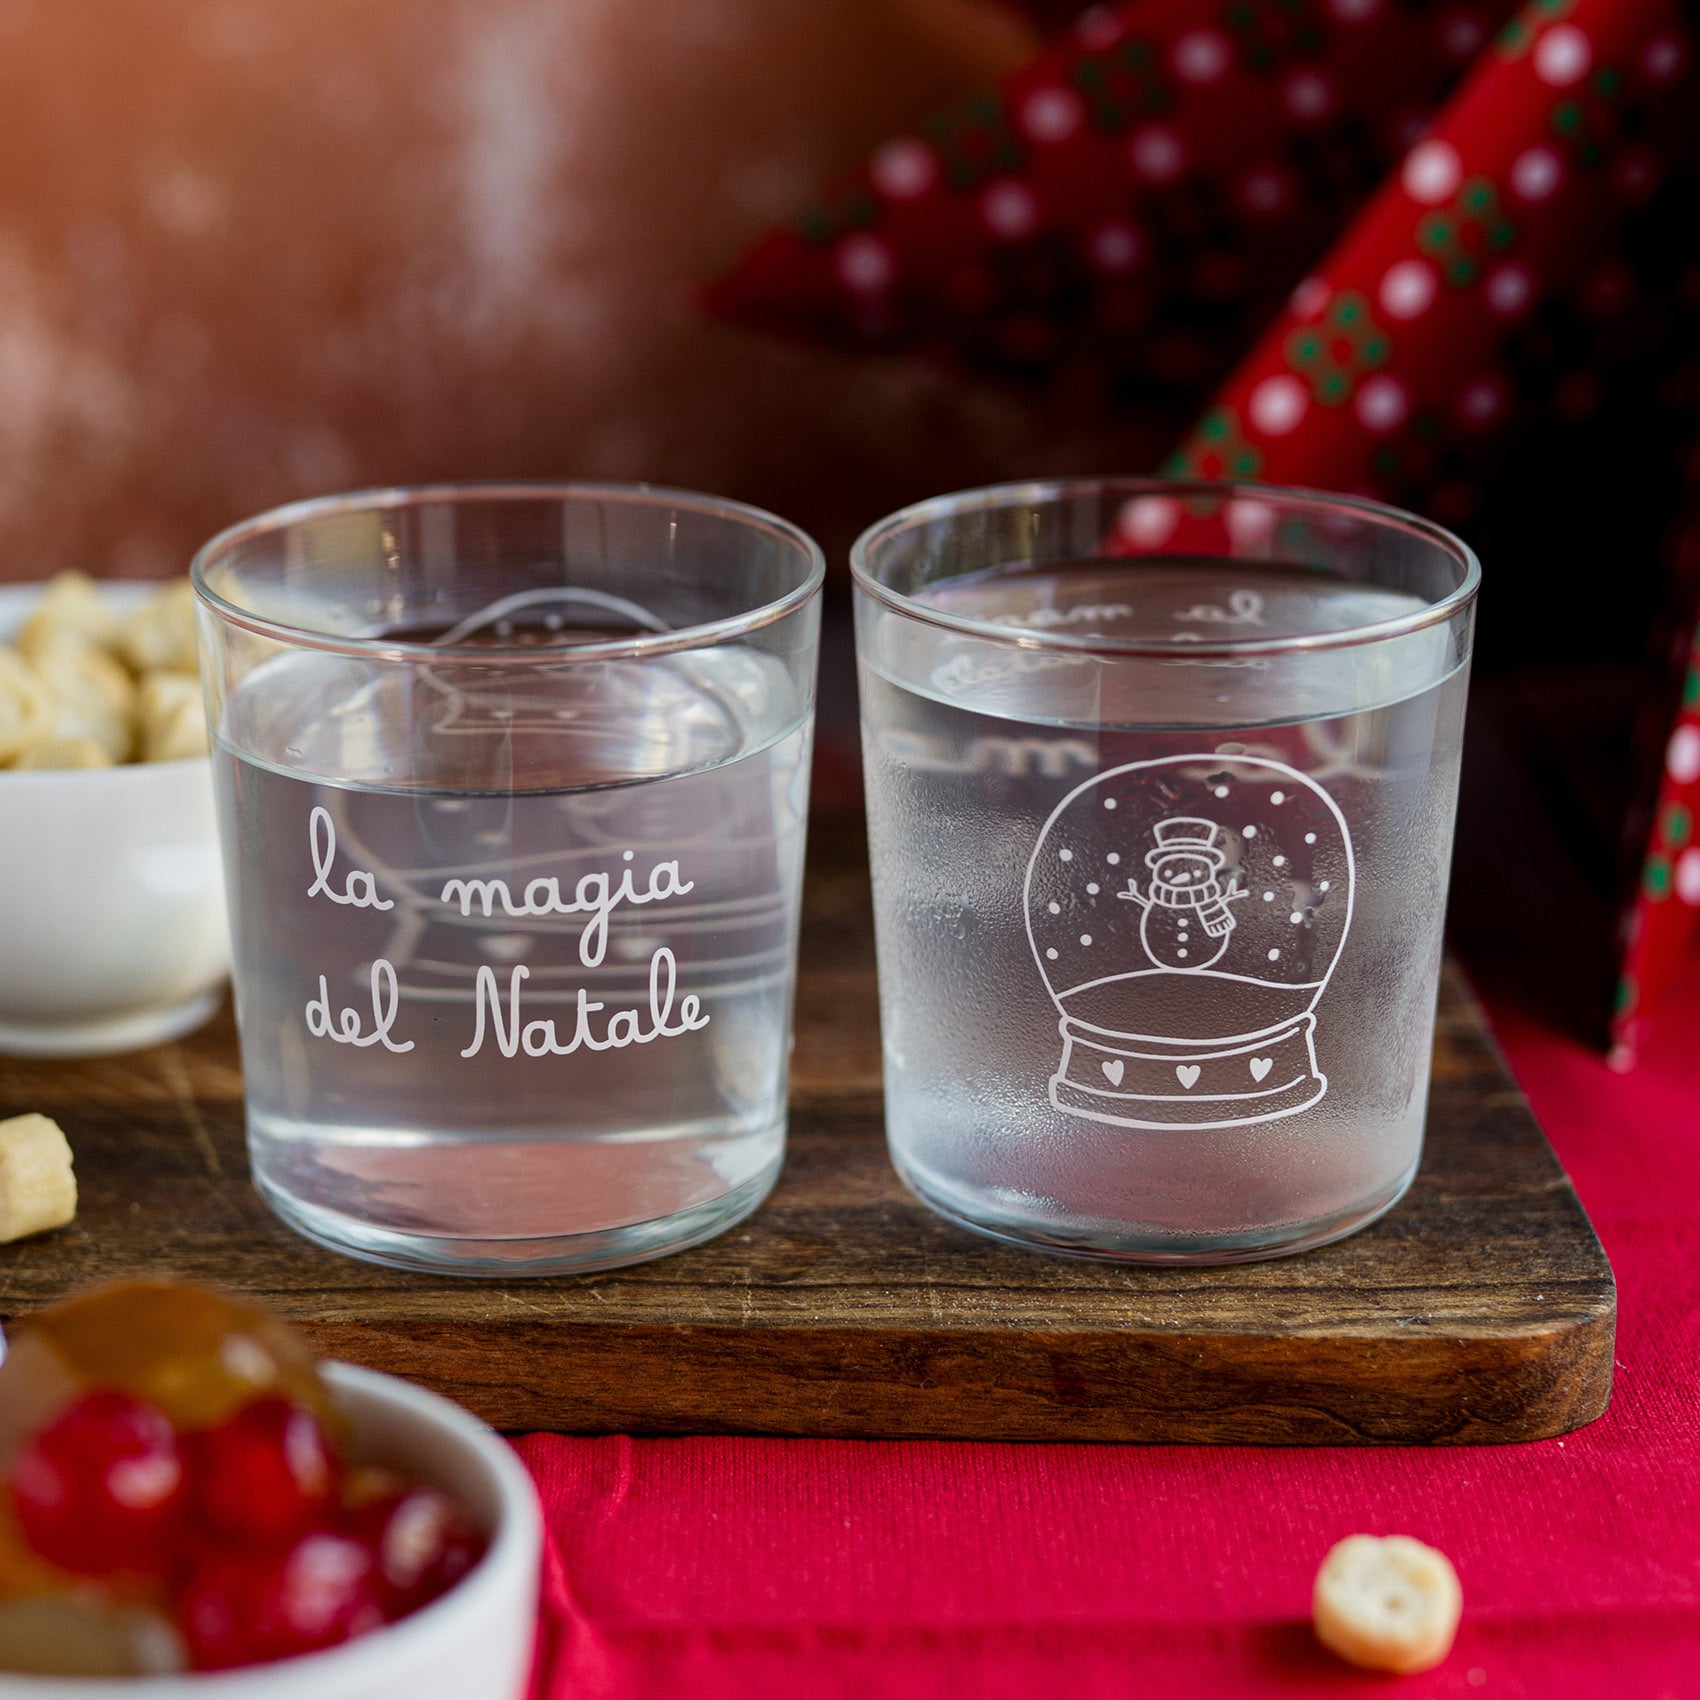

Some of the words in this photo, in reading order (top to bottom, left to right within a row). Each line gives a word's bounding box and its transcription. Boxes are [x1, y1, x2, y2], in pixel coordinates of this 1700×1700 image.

[308, 806, 394, 910] la
[441, 850, 694, 968] magia
[306, 959, 415, 1053] del
[460, 947, 710, 1058] Natale
